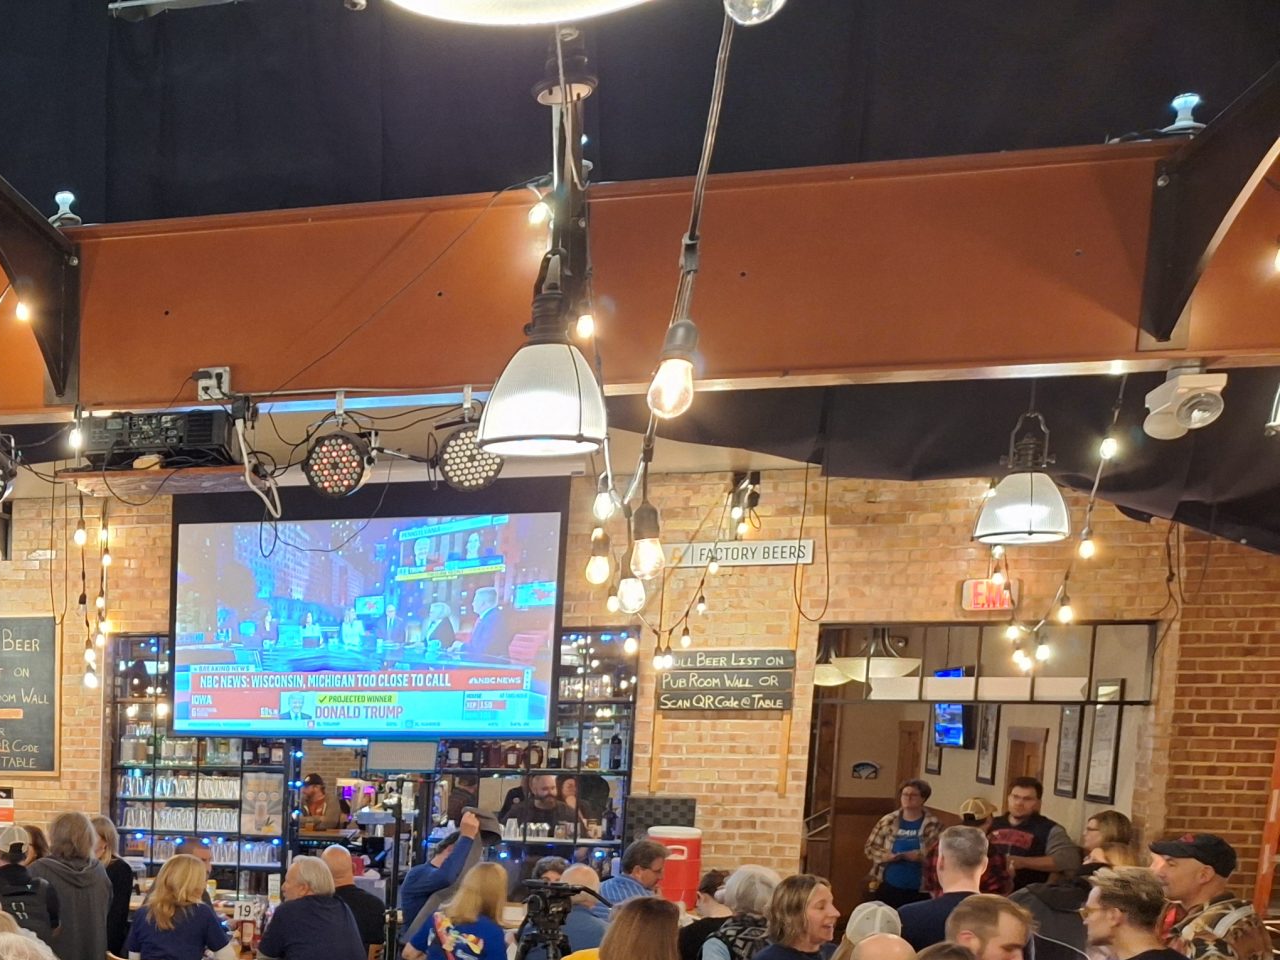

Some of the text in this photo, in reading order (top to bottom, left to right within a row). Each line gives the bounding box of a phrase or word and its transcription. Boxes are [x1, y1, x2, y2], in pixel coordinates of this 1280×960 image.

[699, 545, 806, 562] FACTORY BEERS
[2, 629, 40, 651] BEER
[696, 652, 727, 667] BEER
[731, 652, 762, 666] LIST
[765, 656, 784, 666] ON
[13, 667, 30, 678] ON
[200, 673, 451, 689] NBC NEWS: WISCONSIN, MICHIGAN TOO CLOSE TO CALL
[662, 673, 779, 689] PUB ROOM WALL OR
[21, 687, 50, 705] WALL
[191, 694, 213, 705] IOWA
[328, 695, 393, 703] PROJECTED WINNER
[659, 694, 691, 709] SCAN
[692, 695, 715, 710] QR
[740, 697, 751, 708] @
[751, 694, 784, 709] TABLE
[315, 705, 404, 720] DONALD TRUMP
[12, 739, 39, 753] CODE
[1, 756, 37, 768] TABLE
[238, 904, 252, 917] 19
